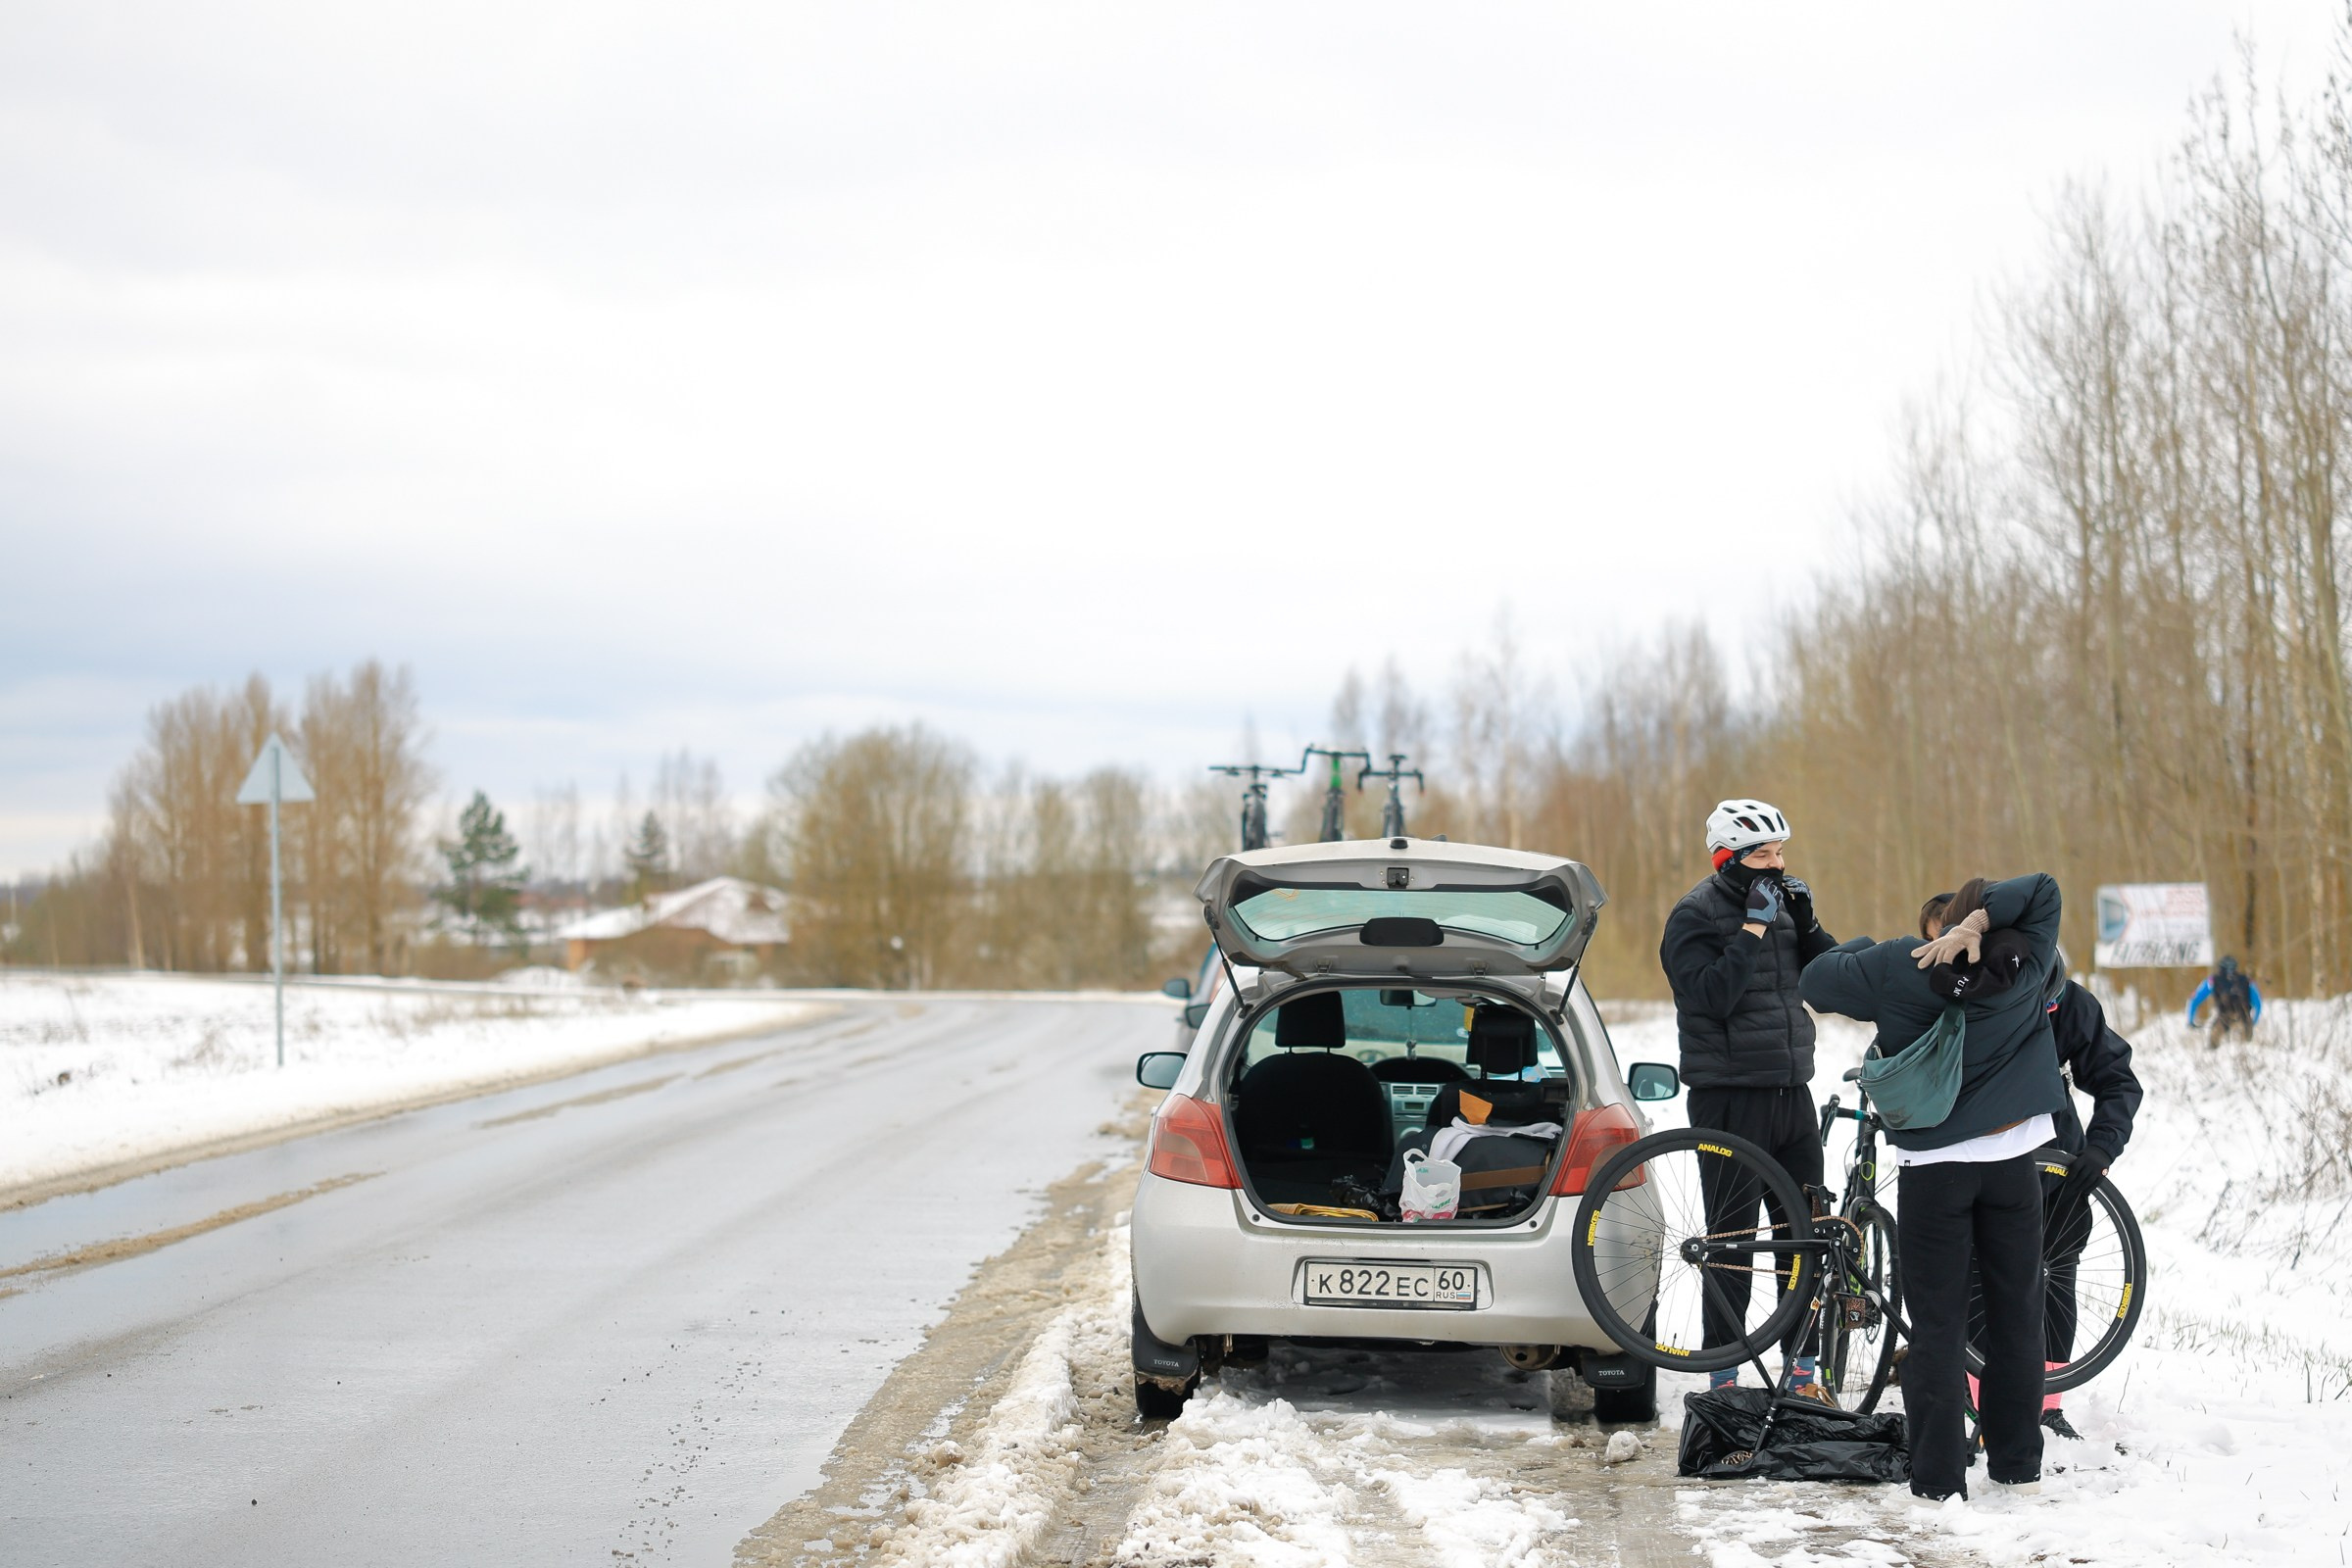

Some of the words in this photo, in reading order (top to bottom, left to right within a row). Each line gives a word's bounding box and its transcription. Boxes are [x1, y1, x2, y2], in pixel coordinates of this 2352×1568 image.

[1697, 1144, 1734, 1157] ANALOG
[1438, 1270, 1465, 1291] 60
[1436, 1291, 1455, 1299] RUS
[1152, 1358, 1180, 1368] TOYOTA
